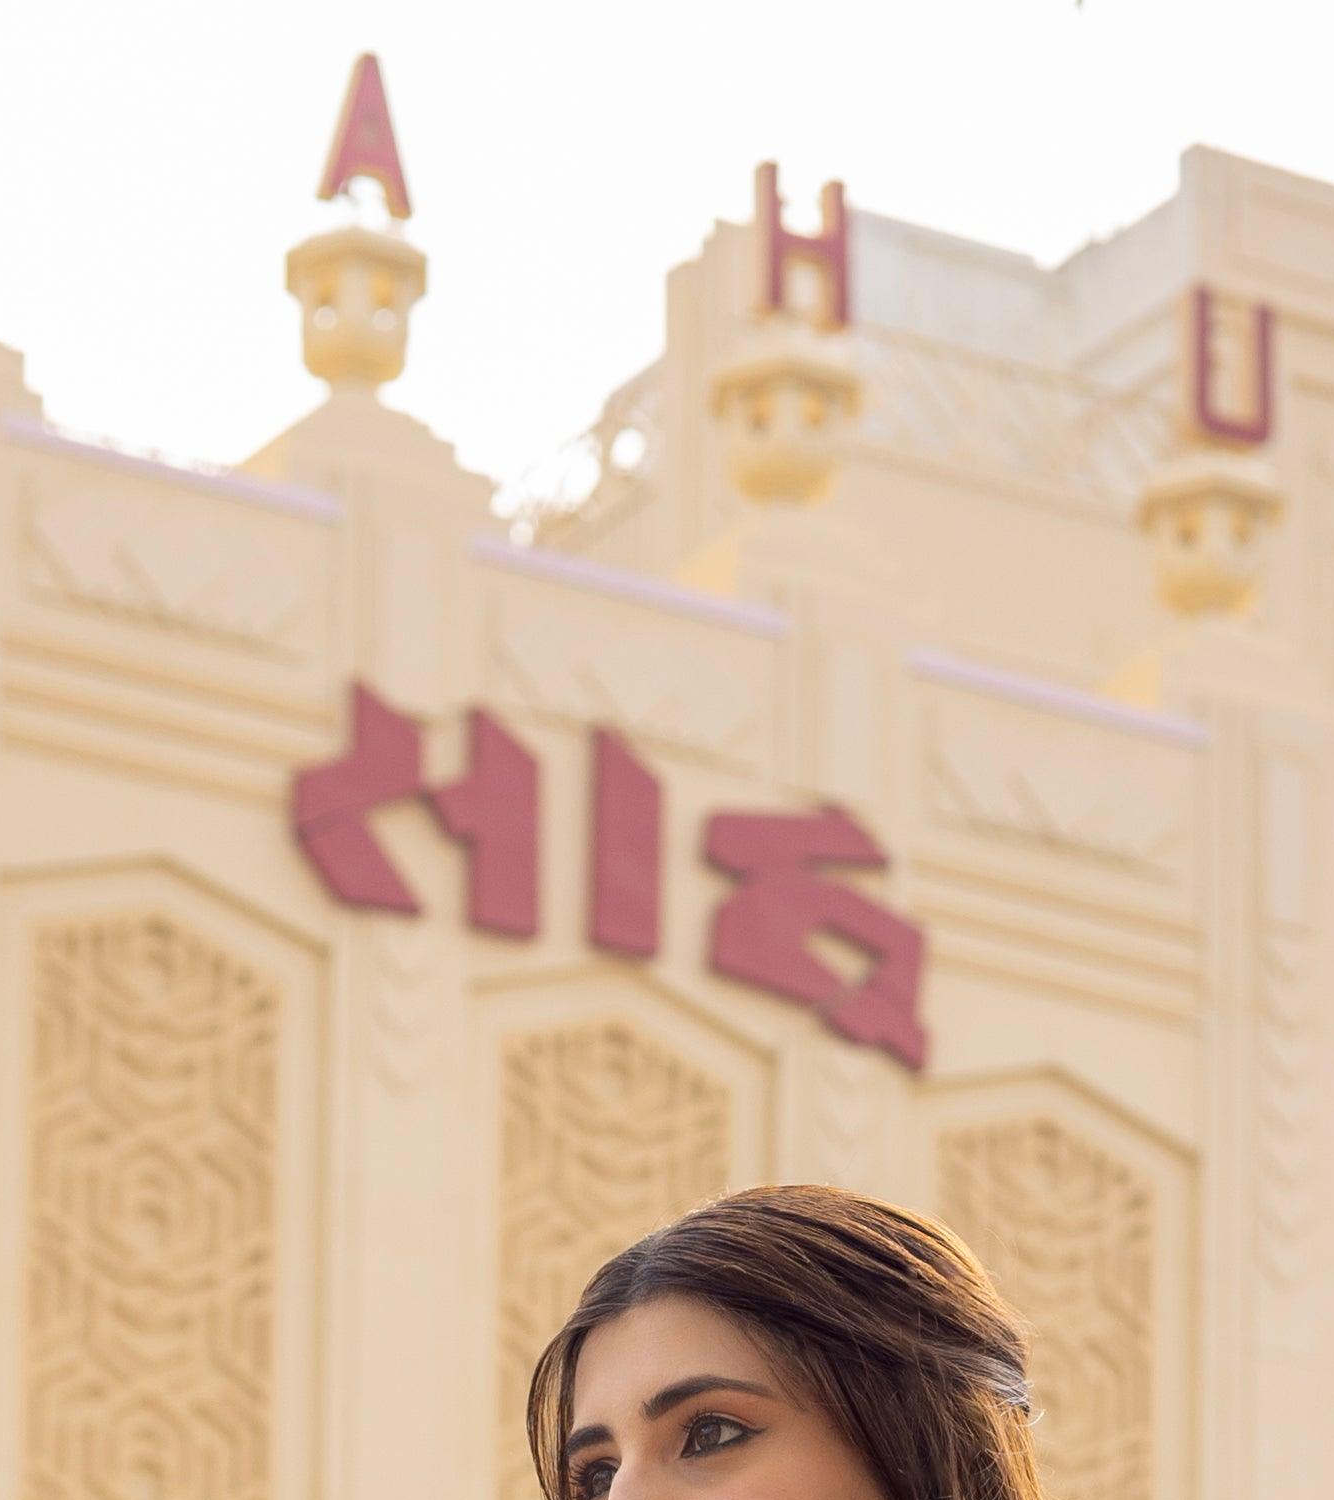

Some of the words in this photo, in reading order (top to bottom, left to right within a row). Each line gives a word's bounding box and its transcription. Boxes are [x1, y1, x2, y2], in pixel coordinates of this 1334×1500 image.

[315, 51, 413, 220] A
[755, 160, 850, 333] H
[1185, 281, 1276, 450] U
